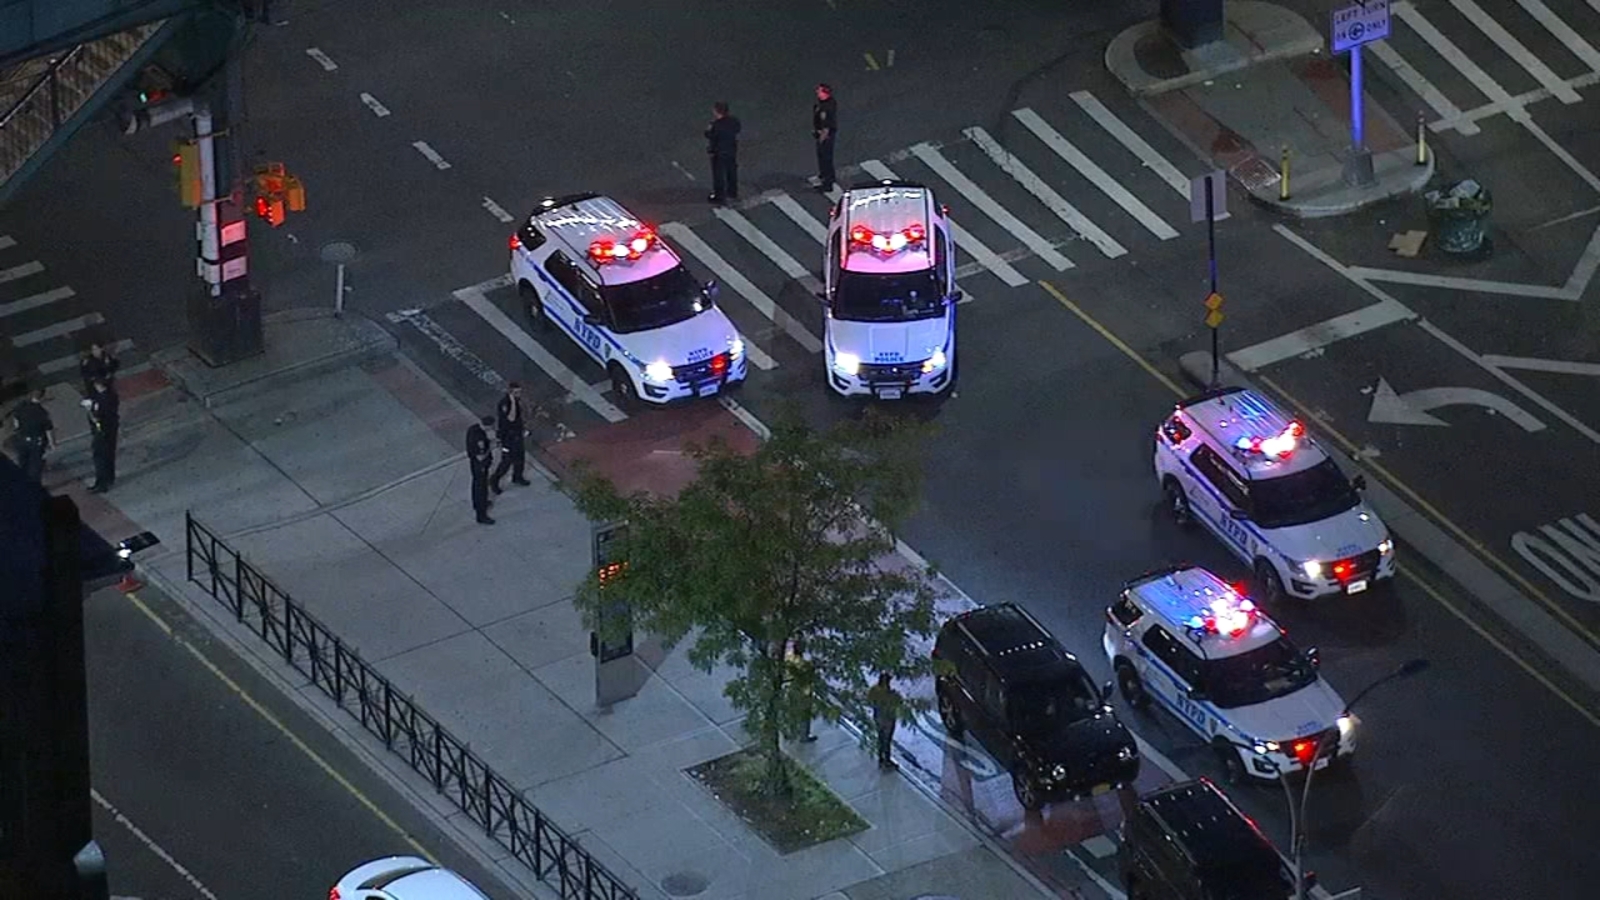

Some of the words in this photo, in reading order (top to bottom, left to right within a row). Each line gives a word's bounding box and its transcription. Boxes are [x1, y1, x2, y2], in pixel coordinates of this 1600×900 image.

[573, 316, 602, 350] NYPD
[1220, 511, 1249, 546] NYPD
[1176, 692, 1206, 725] NYPD
